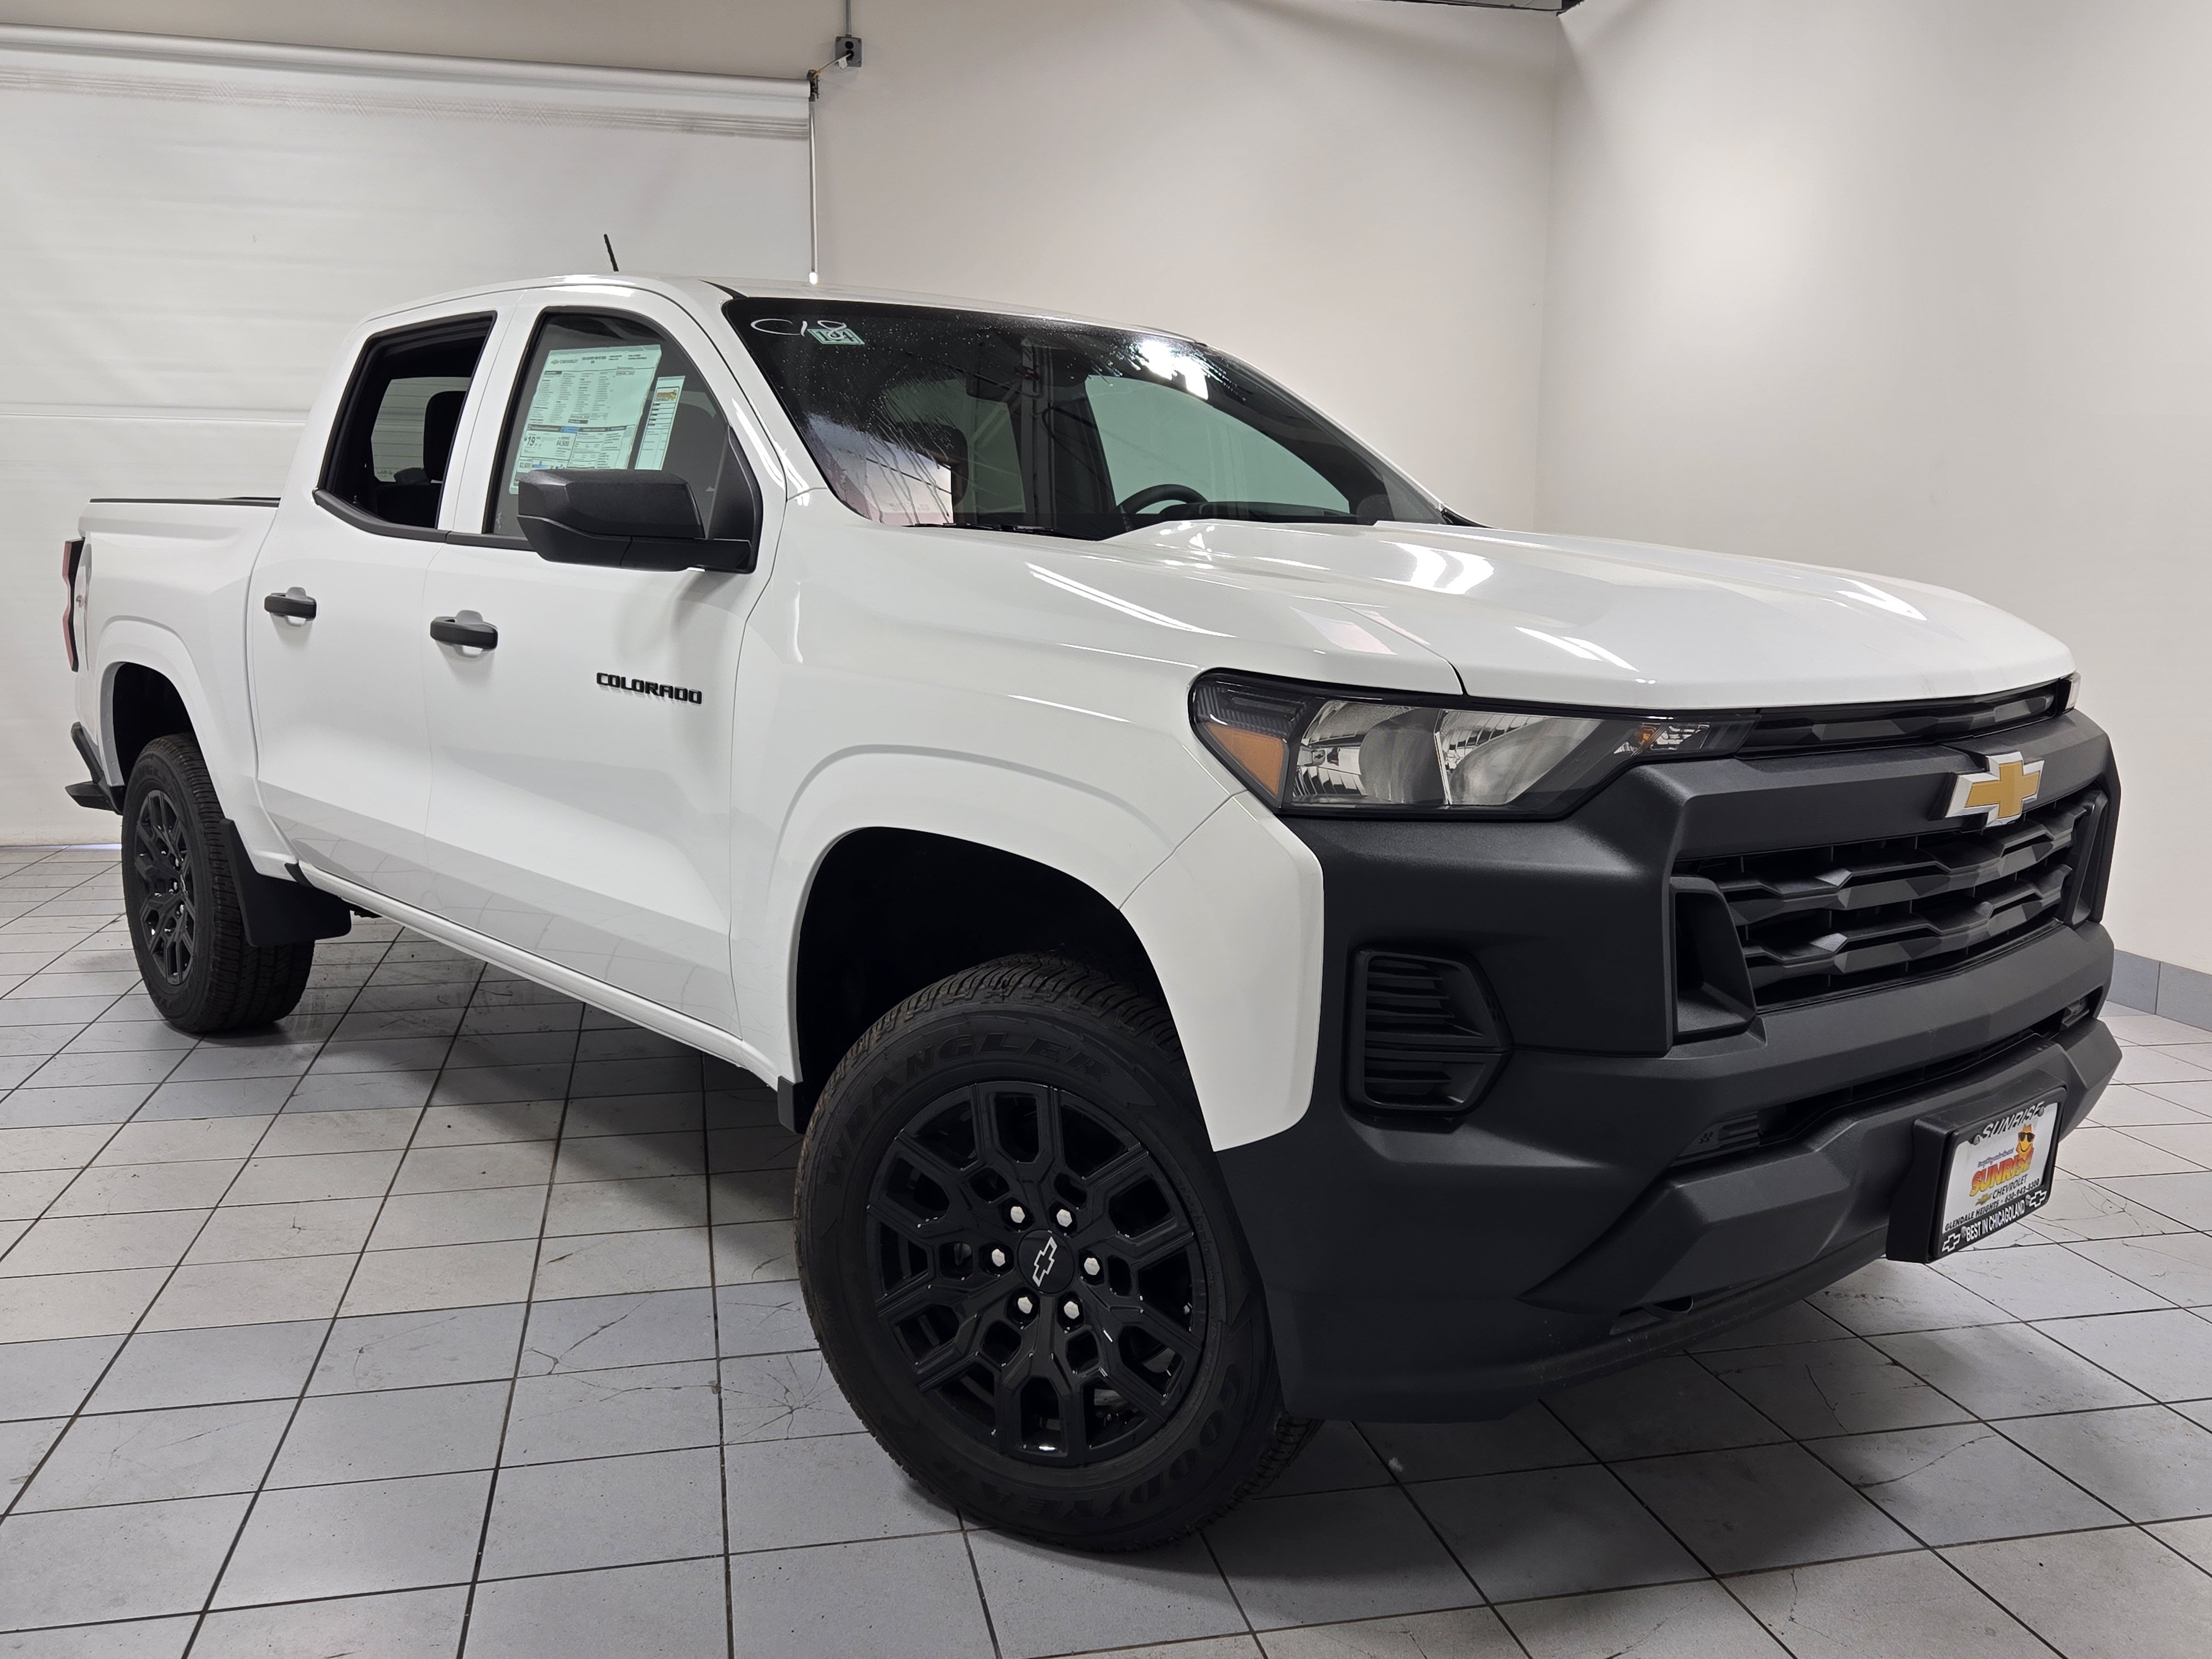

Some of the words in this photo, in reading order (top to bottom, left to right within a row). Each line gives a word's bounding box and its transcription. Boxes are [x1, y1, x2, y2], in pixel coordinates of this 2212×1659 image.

[527, 436, 536, 446] 19
[597, 672, 702, 705] COLORADO
[825, 1033, 1110, 1187] WRANGLER
[1983, 1101, 2045, 1139] SUNRISE
[1969, 1147, 2034, 1197] SUNRISE
[1992, 1173, 2028, 1199] CHEVROLET
[1945, 1212, 1974, 1231] GLENDALE
[1975, 1198, 1999, 1217] HEIGHTS
[1966, 1220, 1981, 1242] BEST
[1981, 1217, 1989, 1234] IN
[1989, 1199, 2026, 1231] CHICAGOLAND
